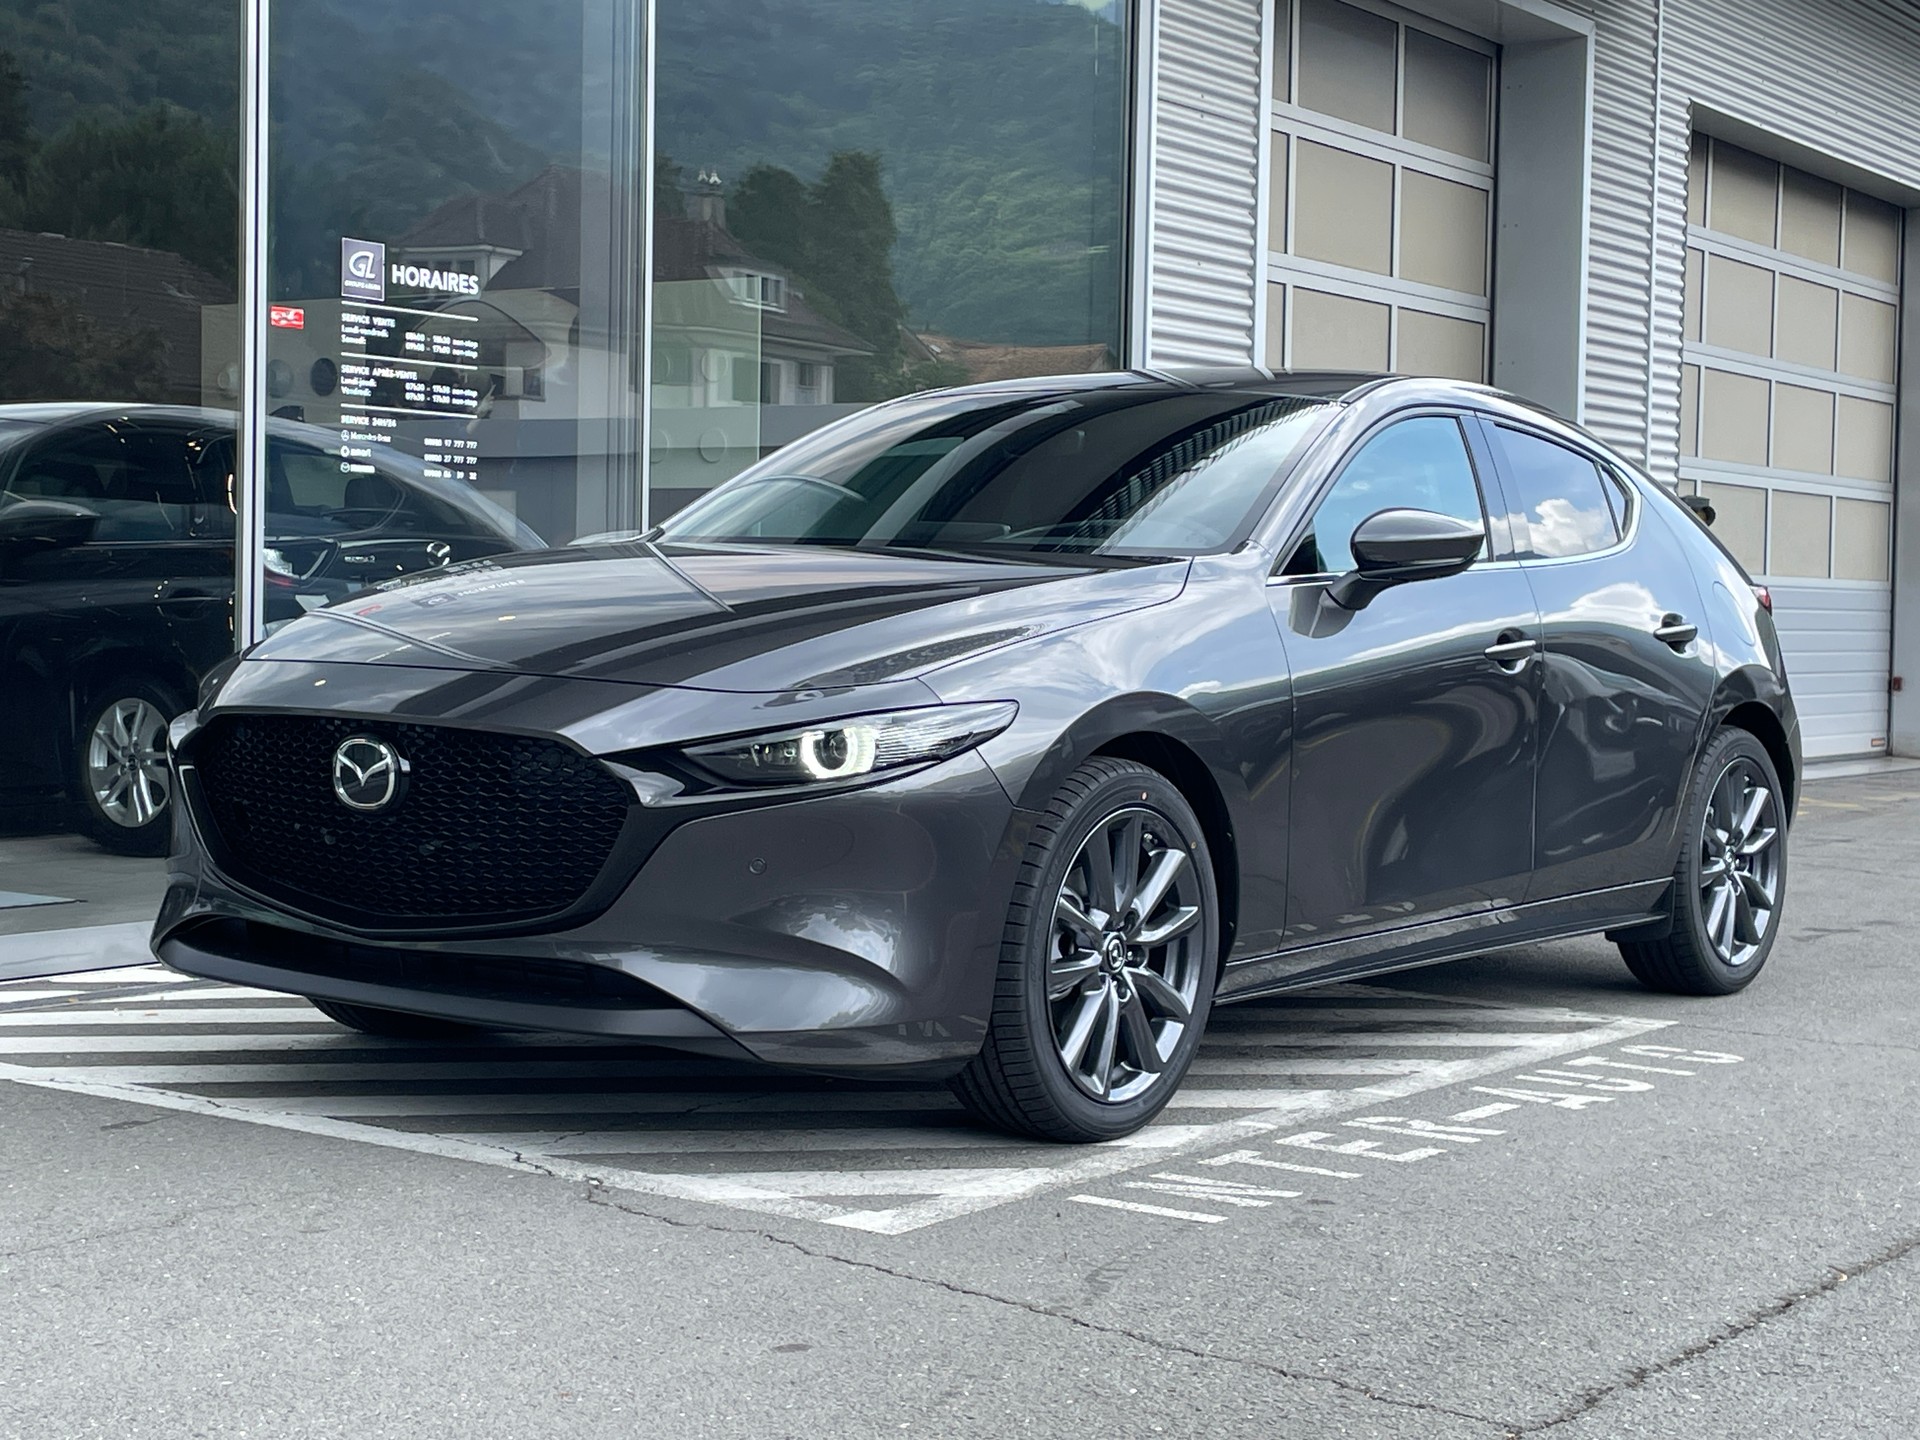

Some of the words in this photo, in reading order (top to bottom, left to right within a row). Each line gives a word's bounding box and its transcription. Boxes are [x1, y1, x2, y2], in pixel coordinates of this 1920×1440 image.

[349, 250, 376, 279] GL
[391, 264, 479, 295] HORAIRES
[341, 312, 370, 325] SERVICE
[372, 316, 396, 328] VENTE
[341, 364, 370, 376] SERVICE
[372, 366, 418, 380] APRÈS-VENTE
[341, 414, 370, 426] SERVICE
[350, 431, 391, 443] Mercedes-Benz
[1066, 1044, 1744, 1224] INTER-AUTO
